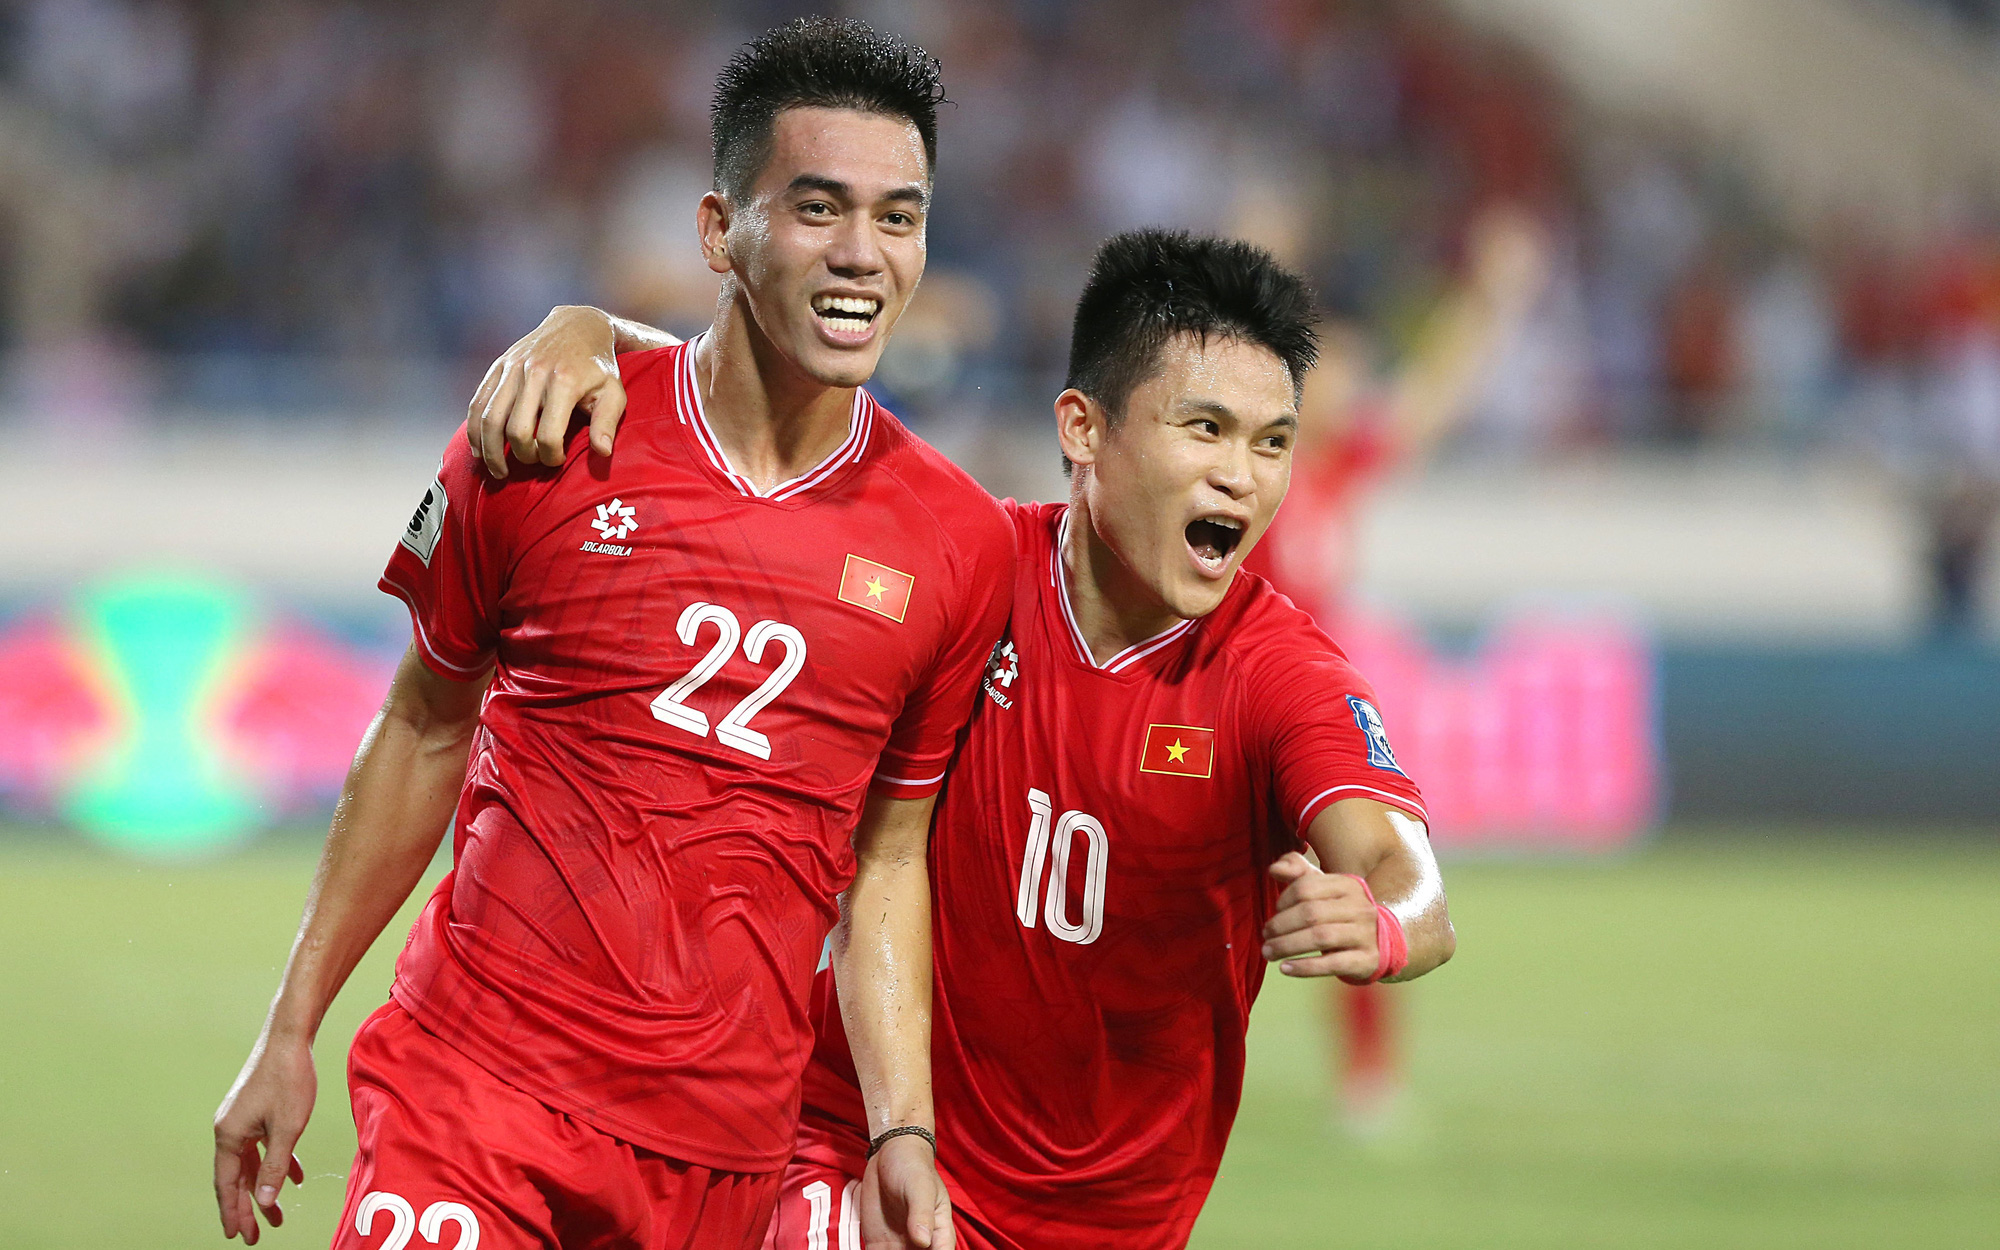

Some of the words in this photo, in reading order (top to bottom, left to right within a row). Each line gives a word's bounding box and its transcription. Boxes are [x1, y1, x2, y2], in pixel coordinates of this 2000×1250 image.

[579, 540, 633, 557] JOCARBOLA
[649, 601, 807, 761] 22
[1017, 787, 1109, 945] 10
